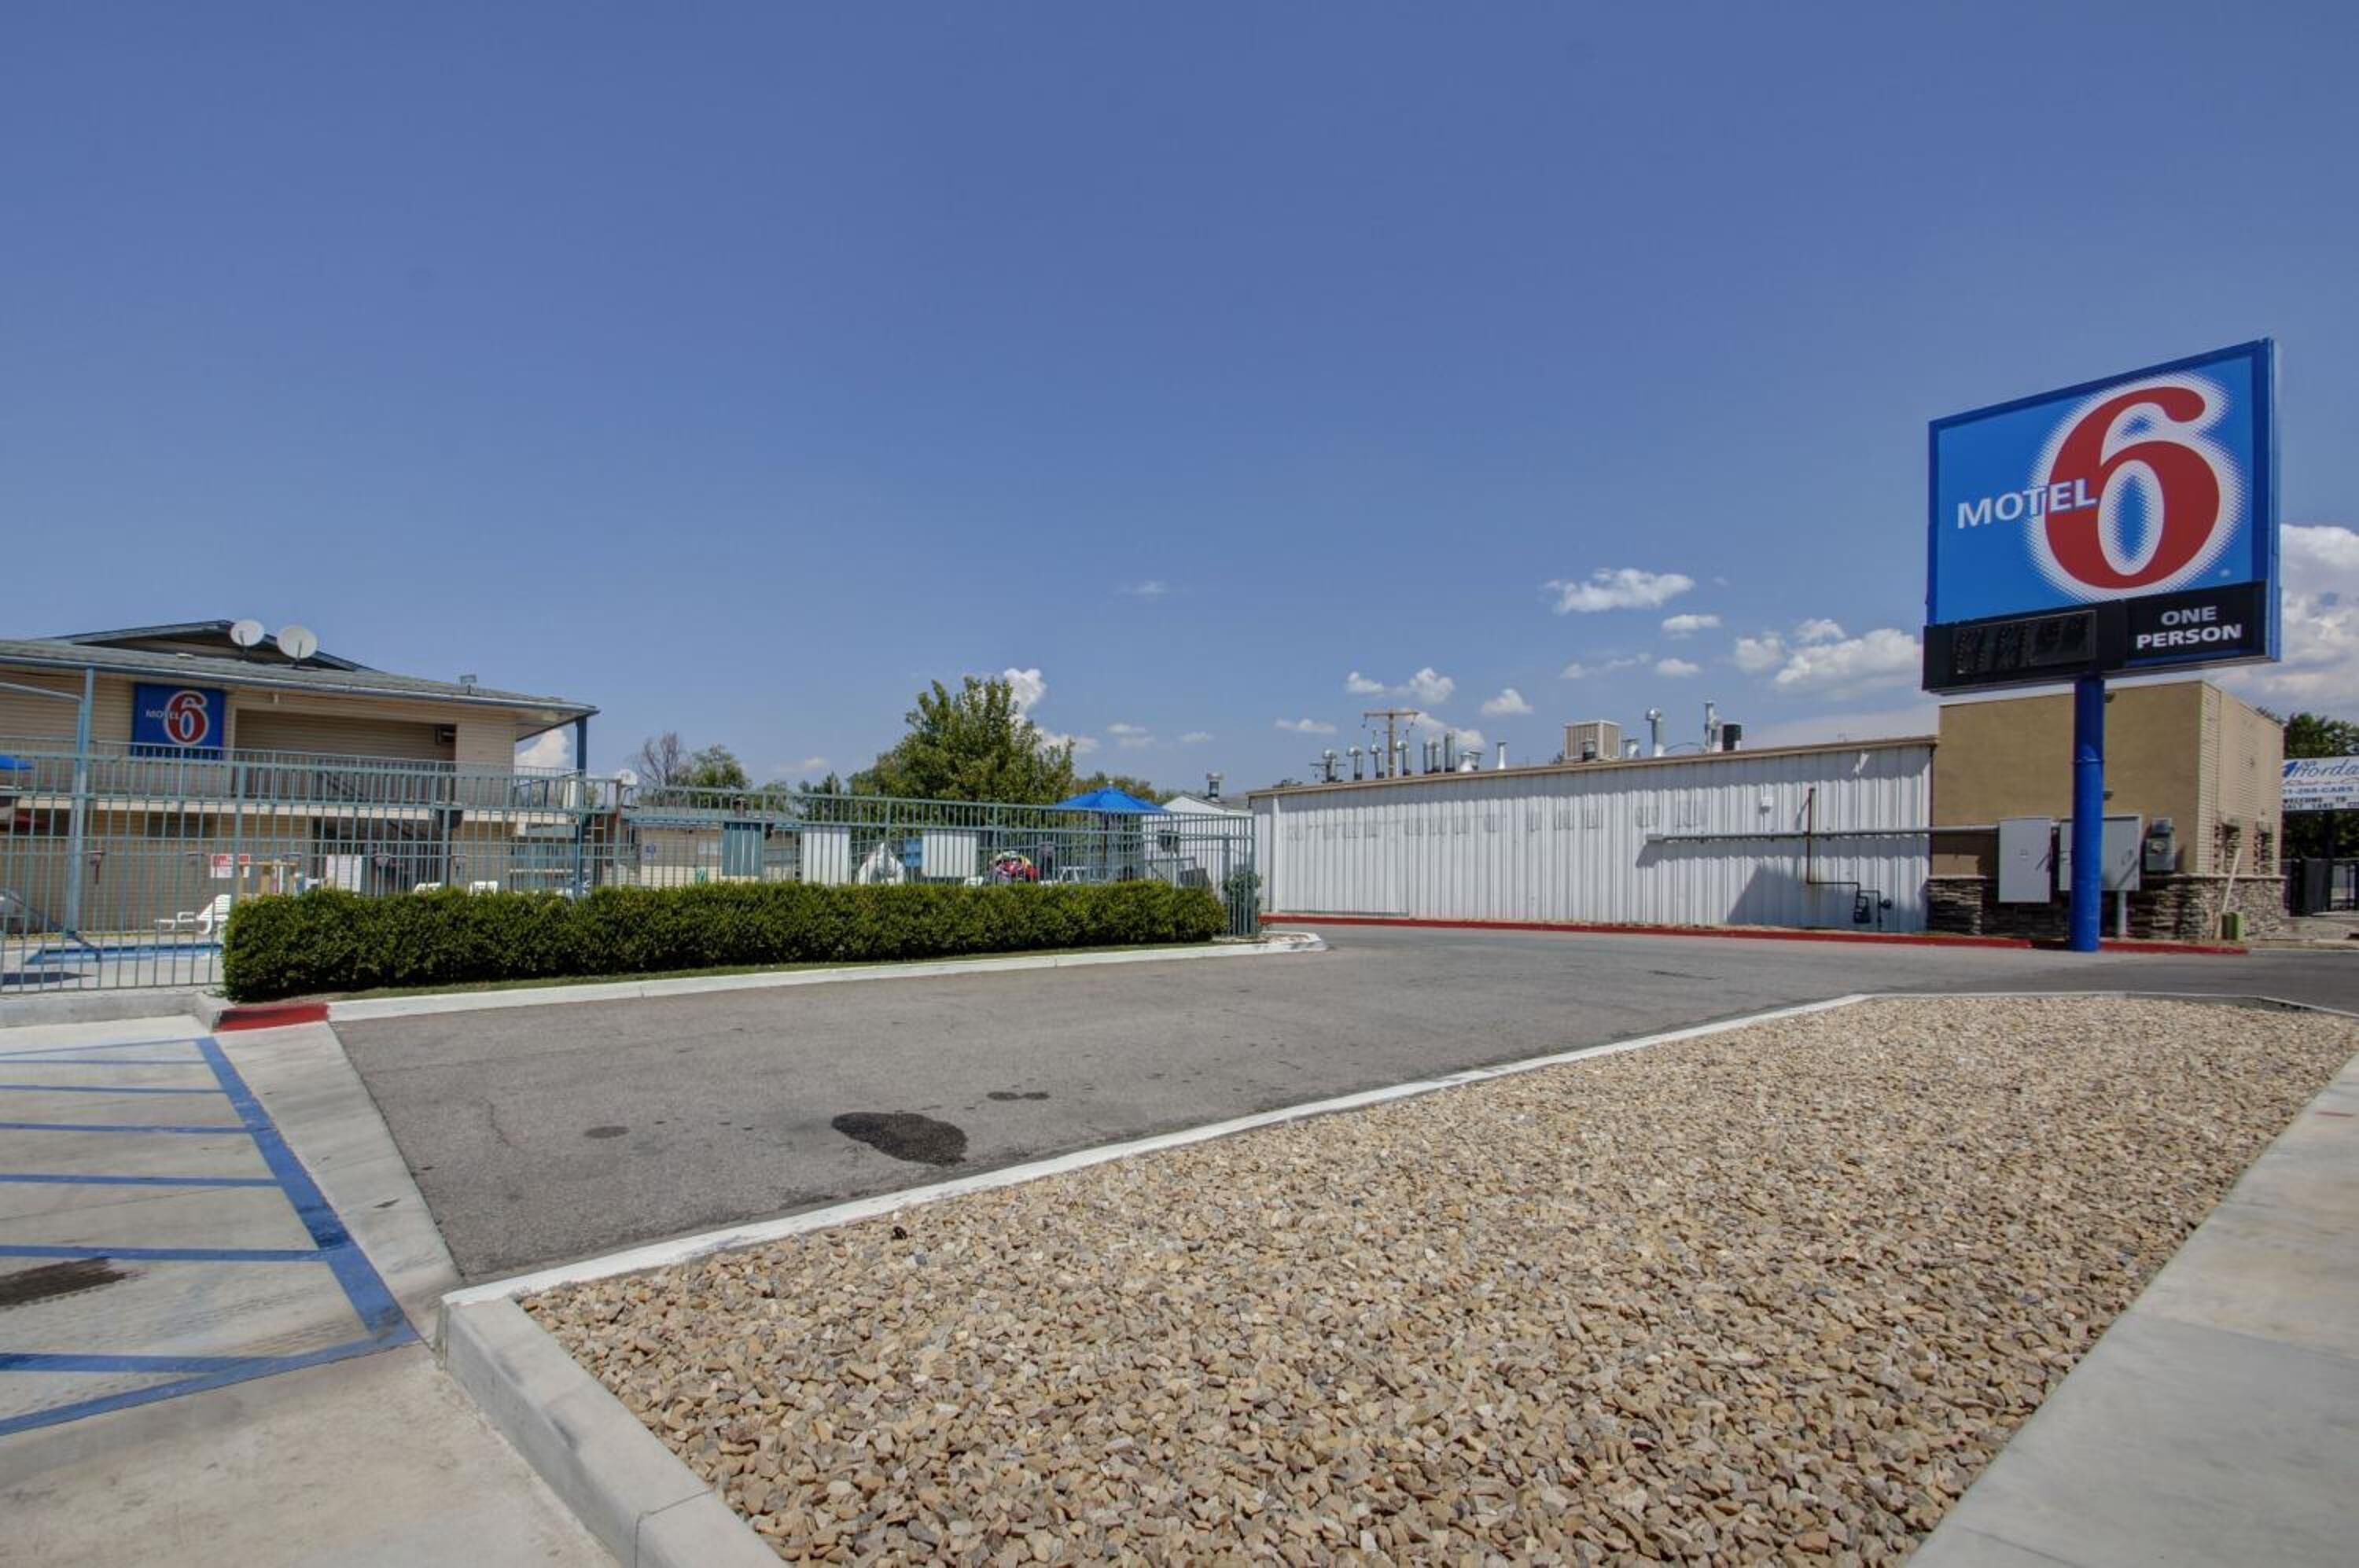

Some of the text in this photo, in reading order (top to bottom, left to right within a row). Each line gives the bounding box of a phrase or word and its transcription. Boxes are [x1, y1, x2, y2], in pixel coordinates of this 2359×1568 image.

[1956, 386, 2220, 589] MOTEL 6
[2161, 605, 2217, 625] ONE
[2136, 624, 2243, 650] PERSON
[145, 692, 208, 745] MOTEL 6
